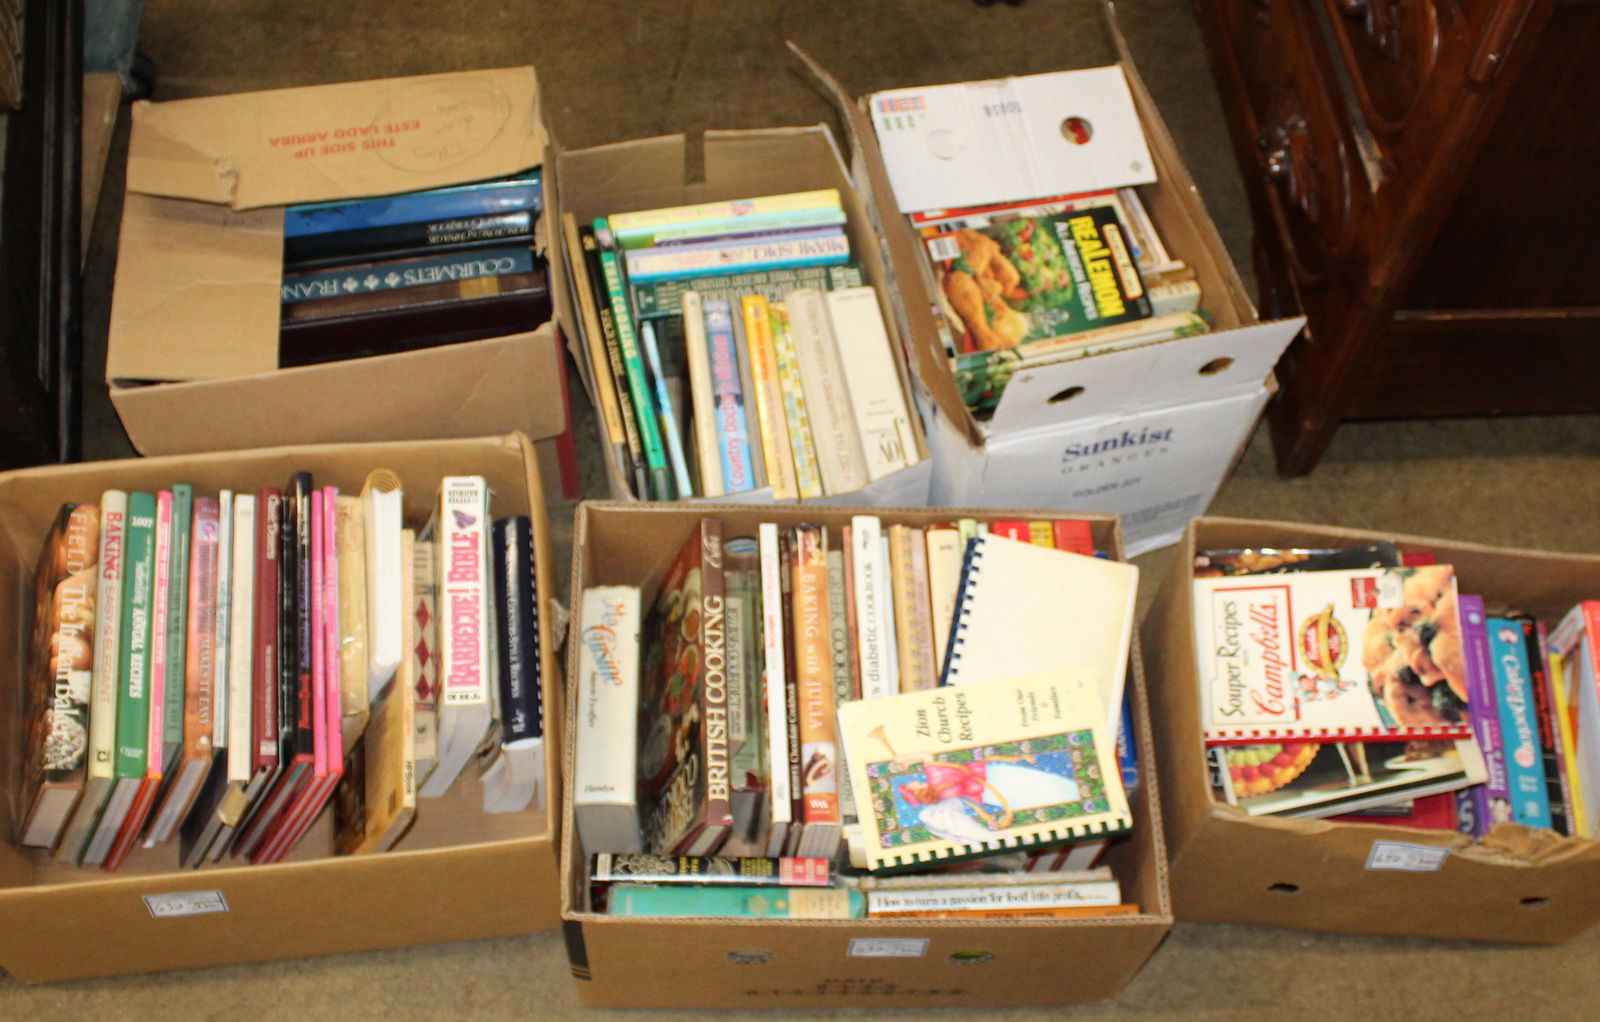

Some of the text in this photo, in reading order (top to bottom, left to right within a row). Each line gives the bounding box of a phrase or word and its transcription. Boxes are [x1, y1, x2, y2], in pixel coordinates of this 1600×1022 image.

[268, 120, 422, 146] ESTE LADO ARRIBA
[294, 137, 397, 159] THIS SIDE UP
[403, 257, 515, 284] GOURMETS
[1069, 215, 1127, 318] REALEMON
[602, 259, 618, 291] THAI
[611, 294, 637, 360] COOKING
[729, 437, 744, 488] Country
[1061, 425, 1174, 462] Sunkist
[66, 512, 87, 576] FIELD
[101, 511, 122, 581] BAKING
[447, 530, 480, 584] BIBLE
[62, 583, 86, 624] The
[447, 587, 480, 689] BARBECUE!
[581, 624, 622, 688] Cuisine
[703, 594, 726, 705] COOKING
[803, 573, 824, 731] BAKING with JULIA
[868, 624, 881, 683] diabetic
[1214, 599, 1245, 718] Souper Recipes
[1248, 597, 1288, 718] Campbell's
[128, 652, 144, 699] RECIPES
[54, 682, 78, 740] Baker
[916, 708, 930, 739] Zion
[936, 696, 953, 745] Church
[958, 692, 975, 742] Recipes
[704, 708, 730, 803] BRITISH
